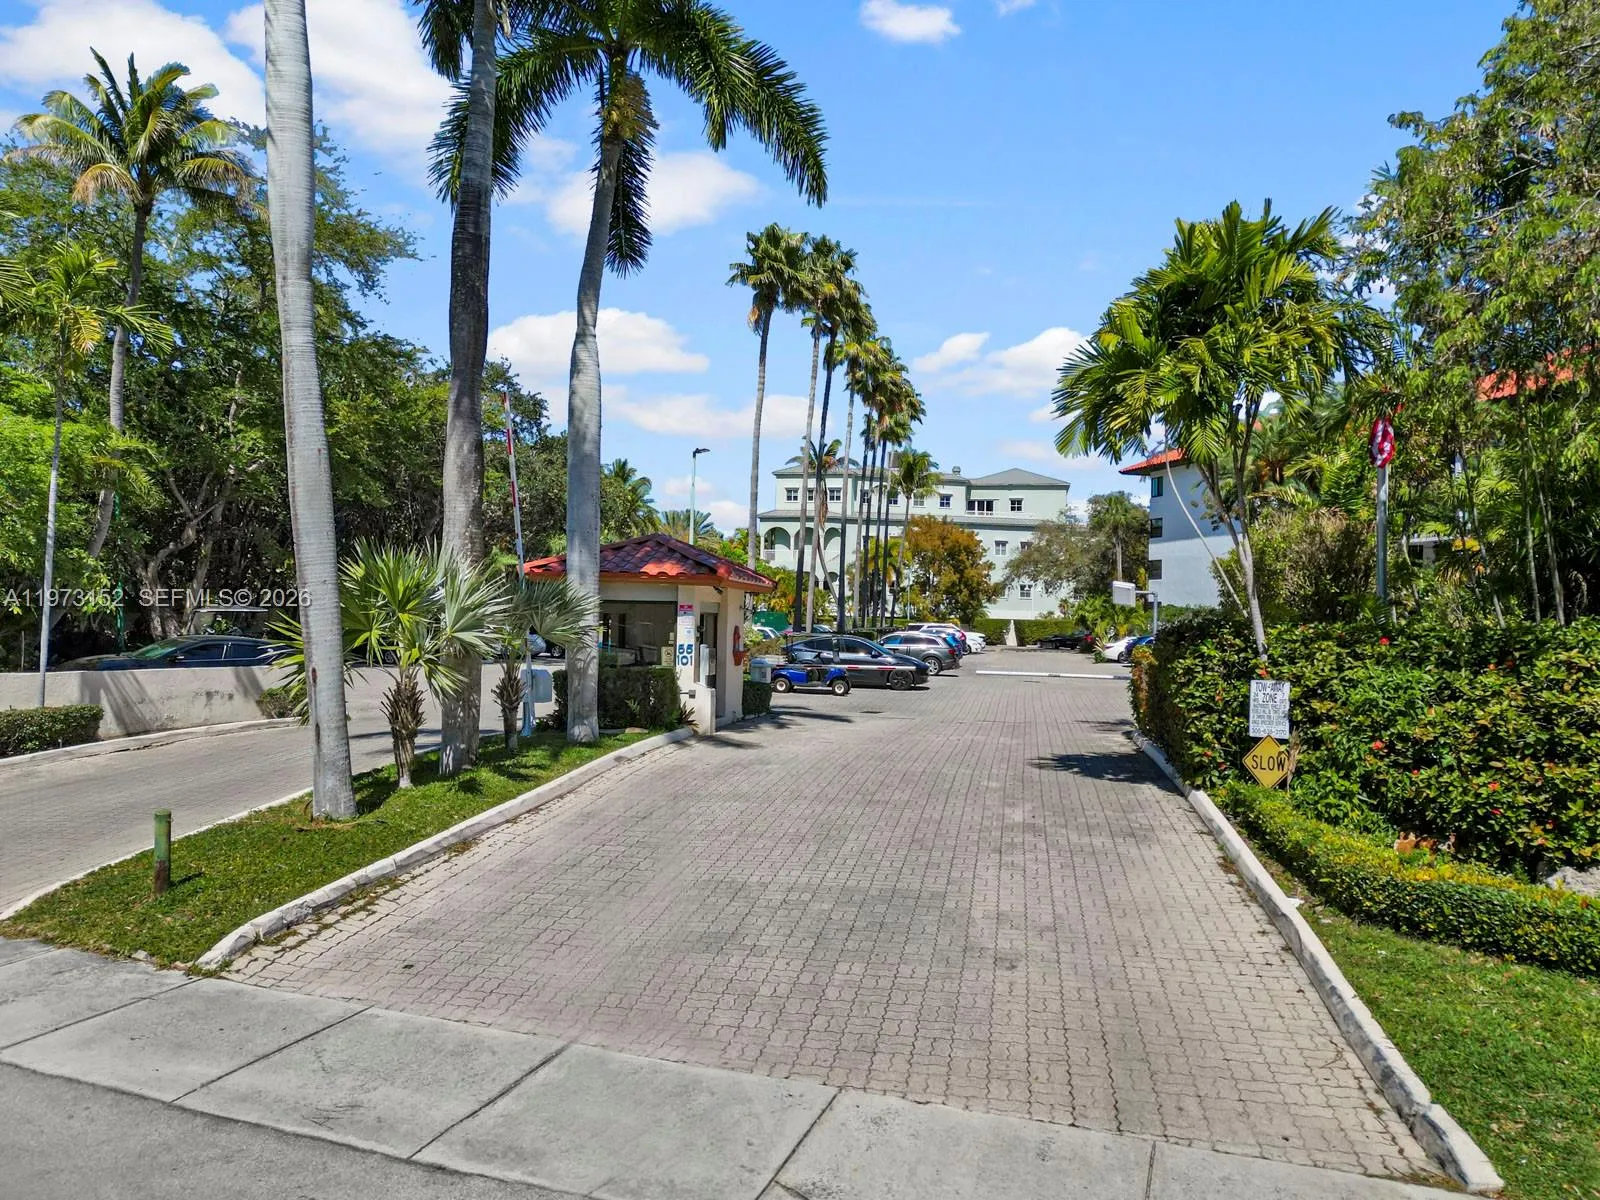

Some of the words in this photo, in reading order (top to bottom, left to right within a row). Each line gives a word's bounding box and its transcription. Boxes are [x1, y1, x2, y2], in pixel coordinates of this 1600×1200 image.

[677, 655, 692, 666] 101
[1262, 692, 1277, 704] ZONE
[1251, 754, 1286, 772] SLOW
